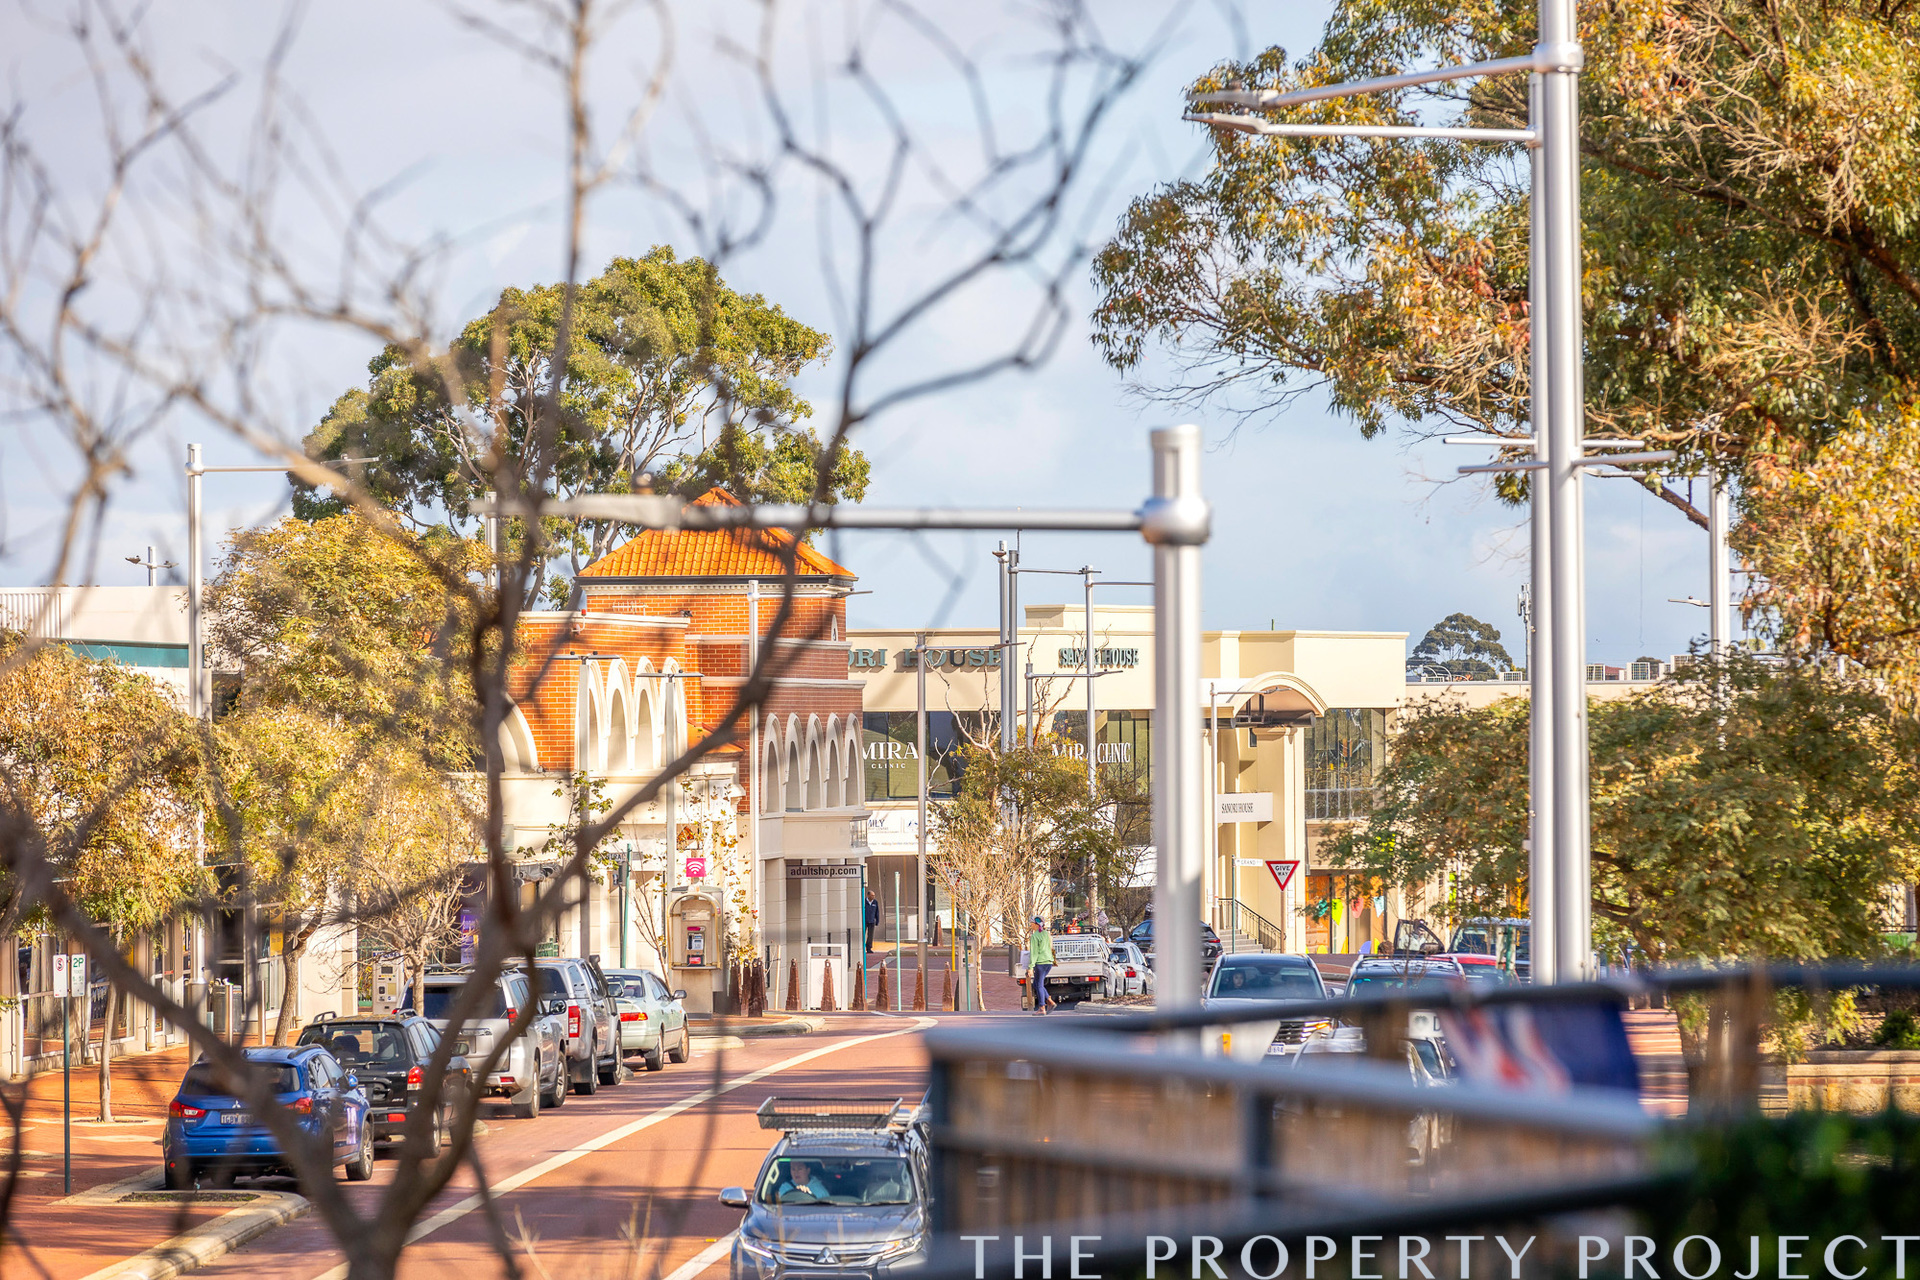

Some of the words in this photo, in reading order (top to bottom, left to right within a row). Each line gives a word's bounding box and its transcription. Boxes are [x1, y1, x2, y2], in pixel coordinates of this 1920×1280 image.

[1101, 648, 1139, 666] HOUSE
[862, 742, 919, 760] MIRA
[1051, 743, 1088, 760] MIR
[1097, 742, 1131, 763] CLINIC
[790, 867, 857, 877] adultshop.com
[73, 957, 84, 967] 2P
